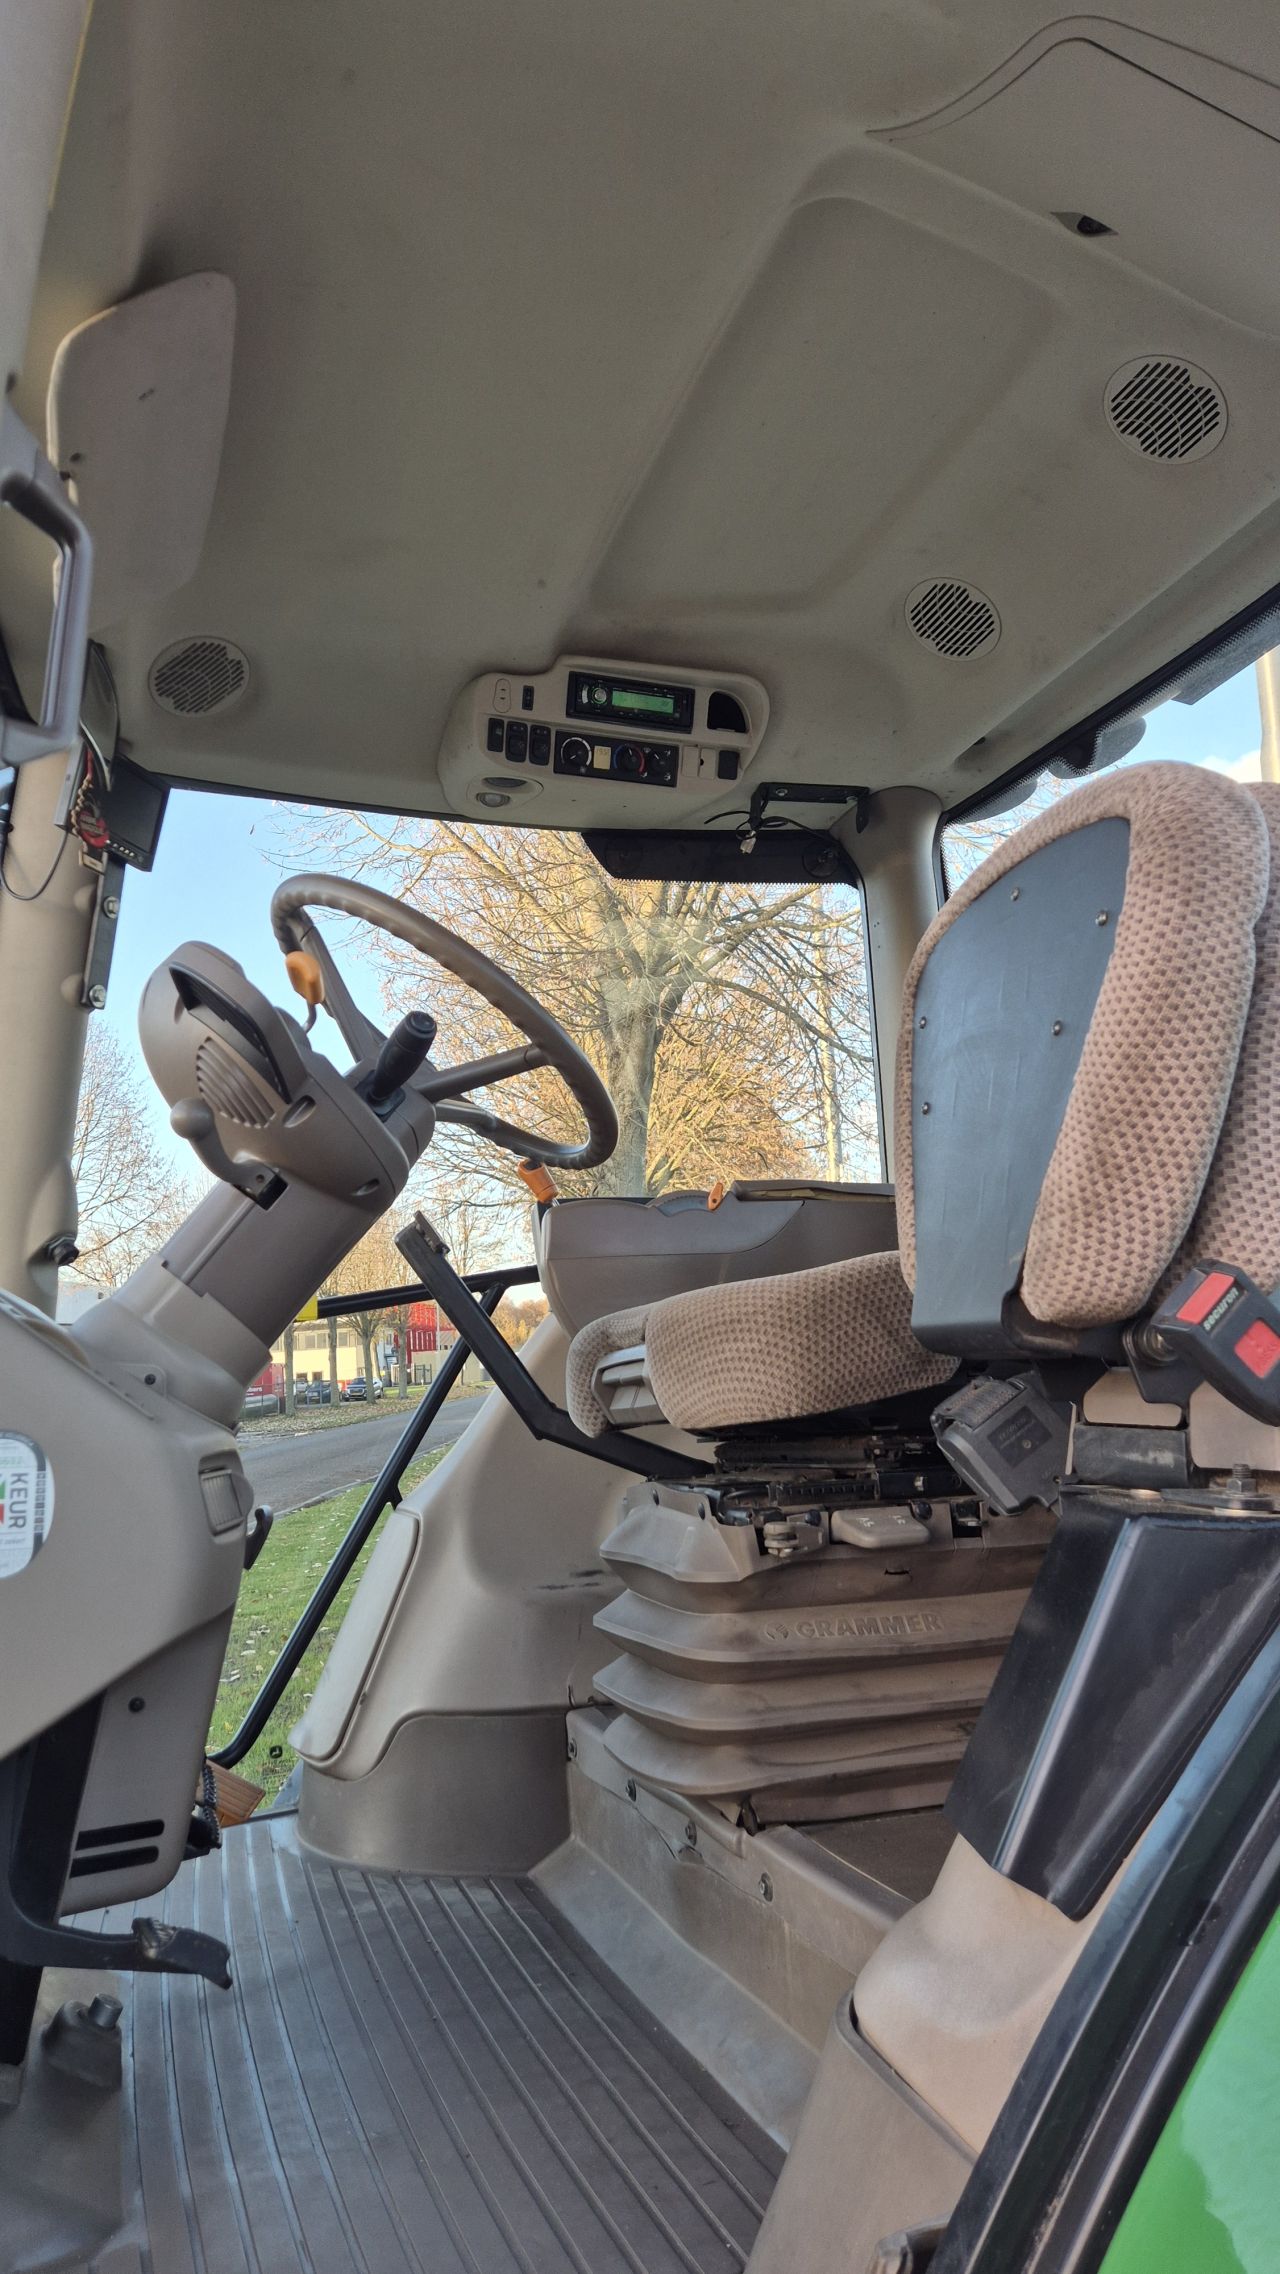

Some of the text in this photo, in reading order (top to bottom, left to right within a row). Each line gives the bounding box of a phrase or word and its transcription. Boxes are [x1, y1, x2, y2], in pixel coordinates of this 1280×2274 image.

[1203, 1286, 1239, 1331] securon
[8, 1472, 28, 1528] KEUR
[796, 1612, 944, 1640] GRAMMER
